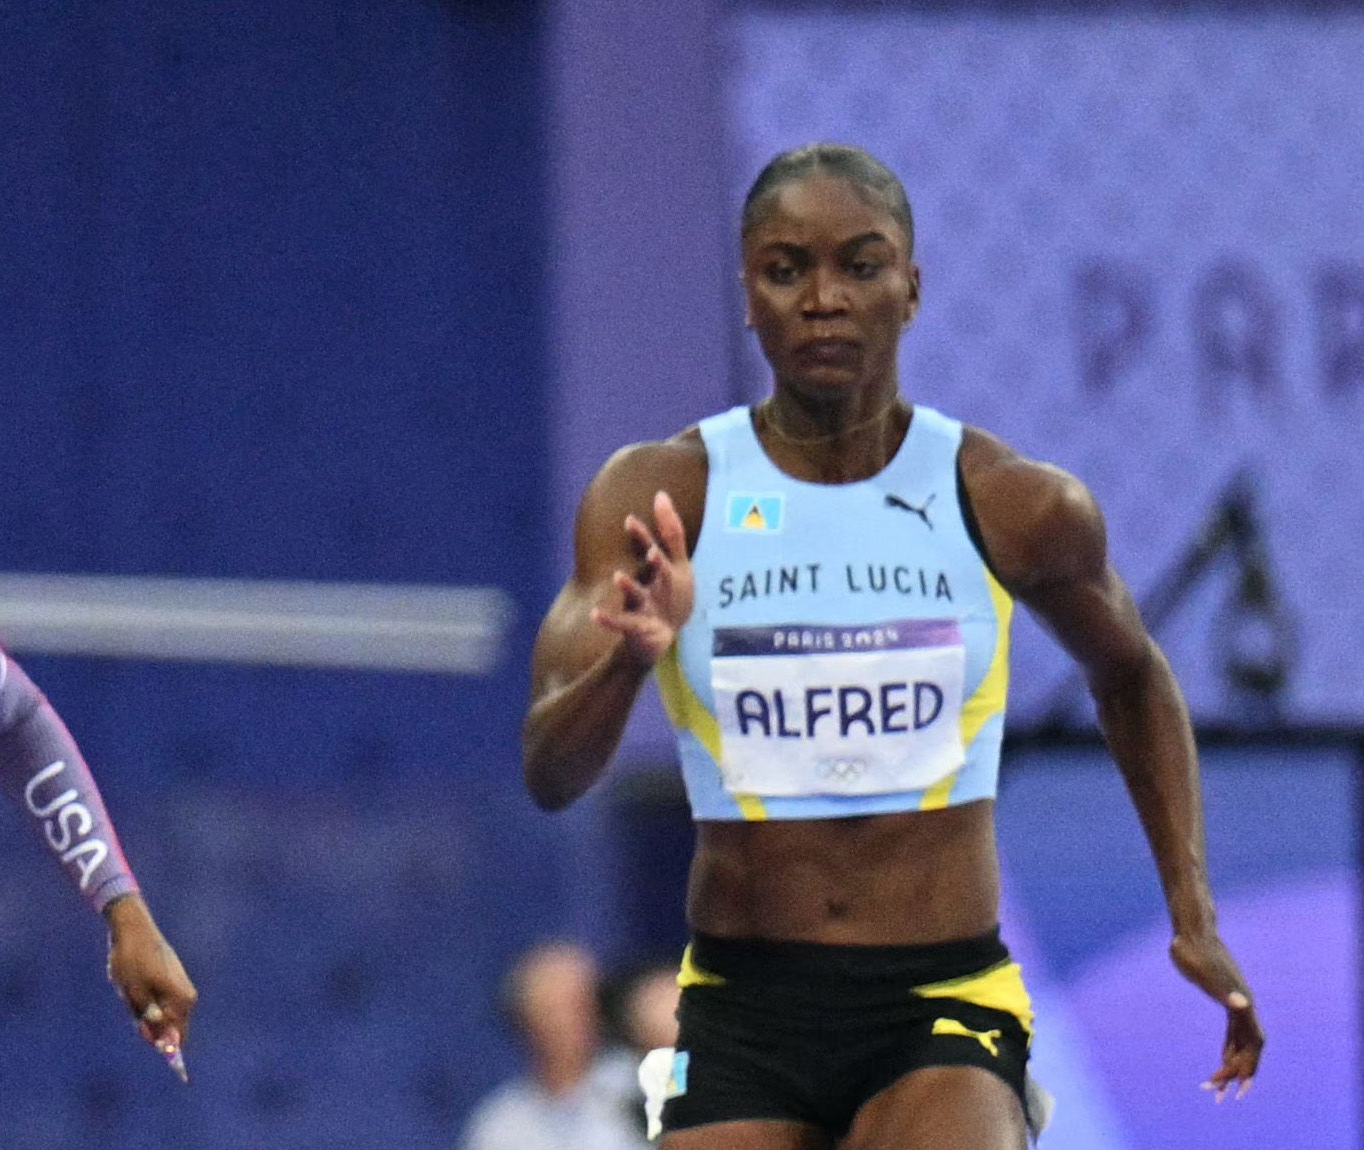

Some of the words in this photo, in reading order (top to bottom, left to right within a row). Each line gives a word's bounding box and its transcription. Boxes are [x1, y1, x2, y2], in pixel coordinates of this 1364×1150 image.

[718, 564, 822, 609] SAINT
[845, 563, 954, 604] LUCIA
[772, 630, 835, 649] PARIS
[734, 681, 945, 738] ALFRED
[25, 760, 109, 890] USA
